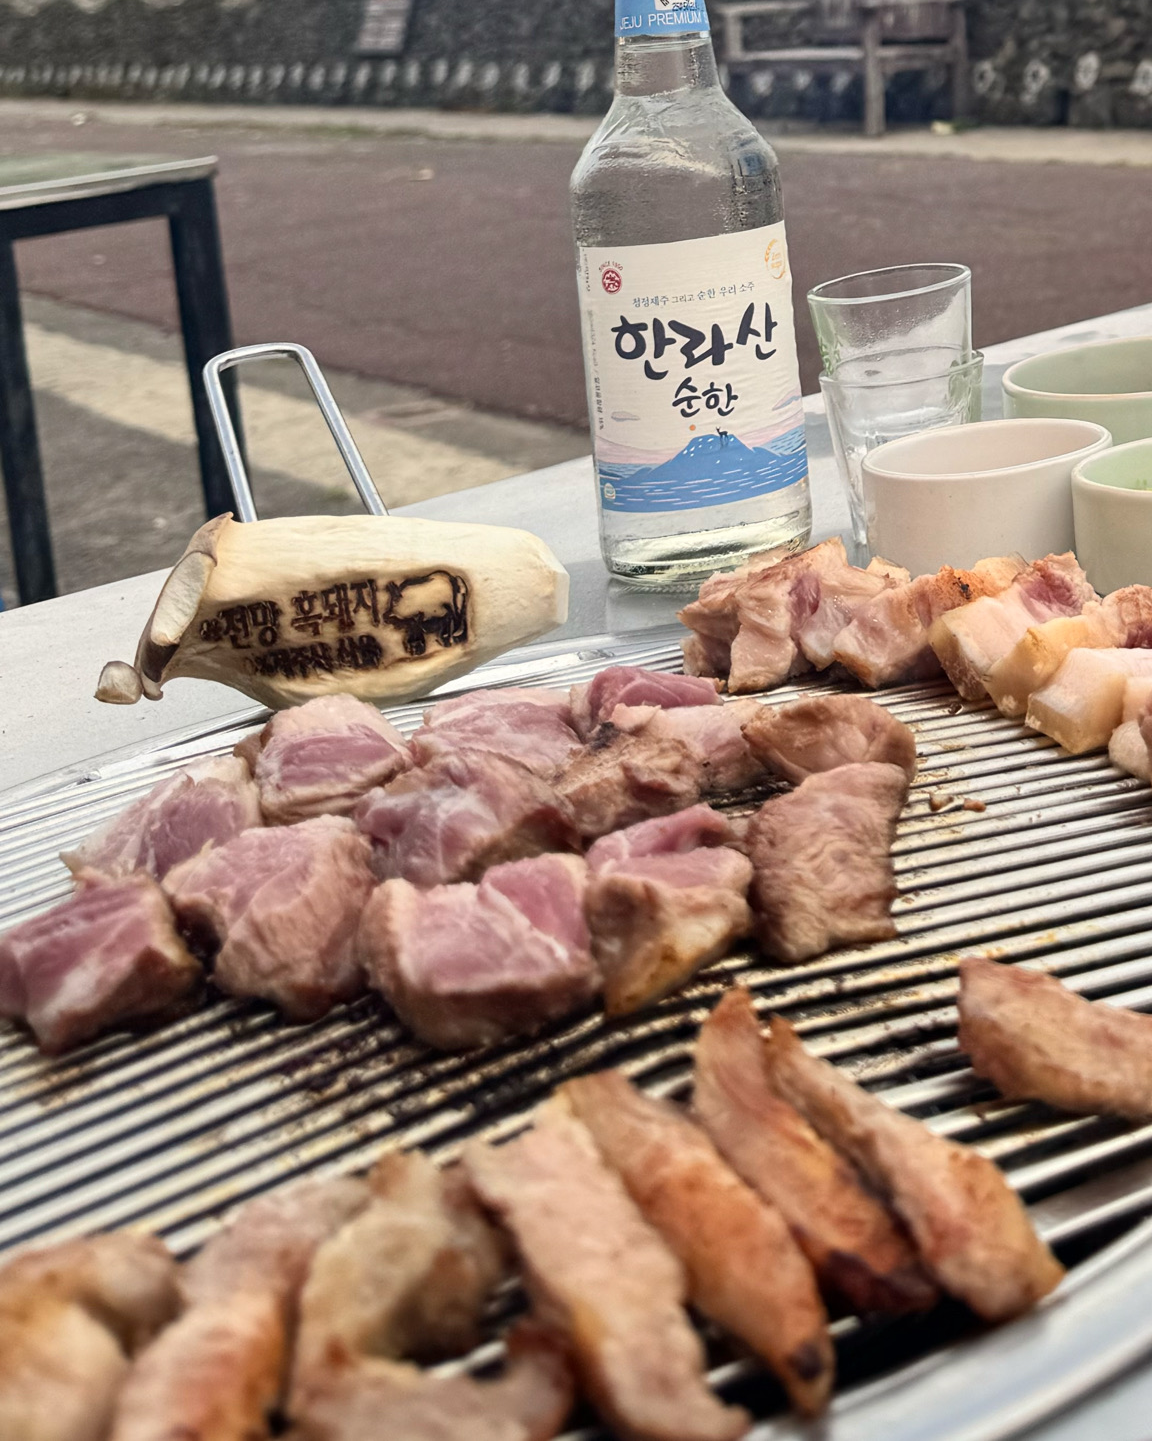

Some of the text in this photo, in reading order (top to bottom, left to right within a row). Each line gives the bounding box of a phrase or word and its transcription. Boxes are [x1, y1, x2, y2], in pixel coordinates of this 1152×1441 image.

[620, 15, 643, 30] JEJU
[648, 10, 703, 27] PREMIUM
[672, 294, 695, 304] 그리고
[697, 288, 716, 301] 순한
[719, 284, 737, 297] 우리
[739, 281, 755, 293] 소주
[611, 302, 778, 380] 한라산
[672, 376, 739, 418] 순한
[219, 578, 381, 649] 전망 흑돼지
